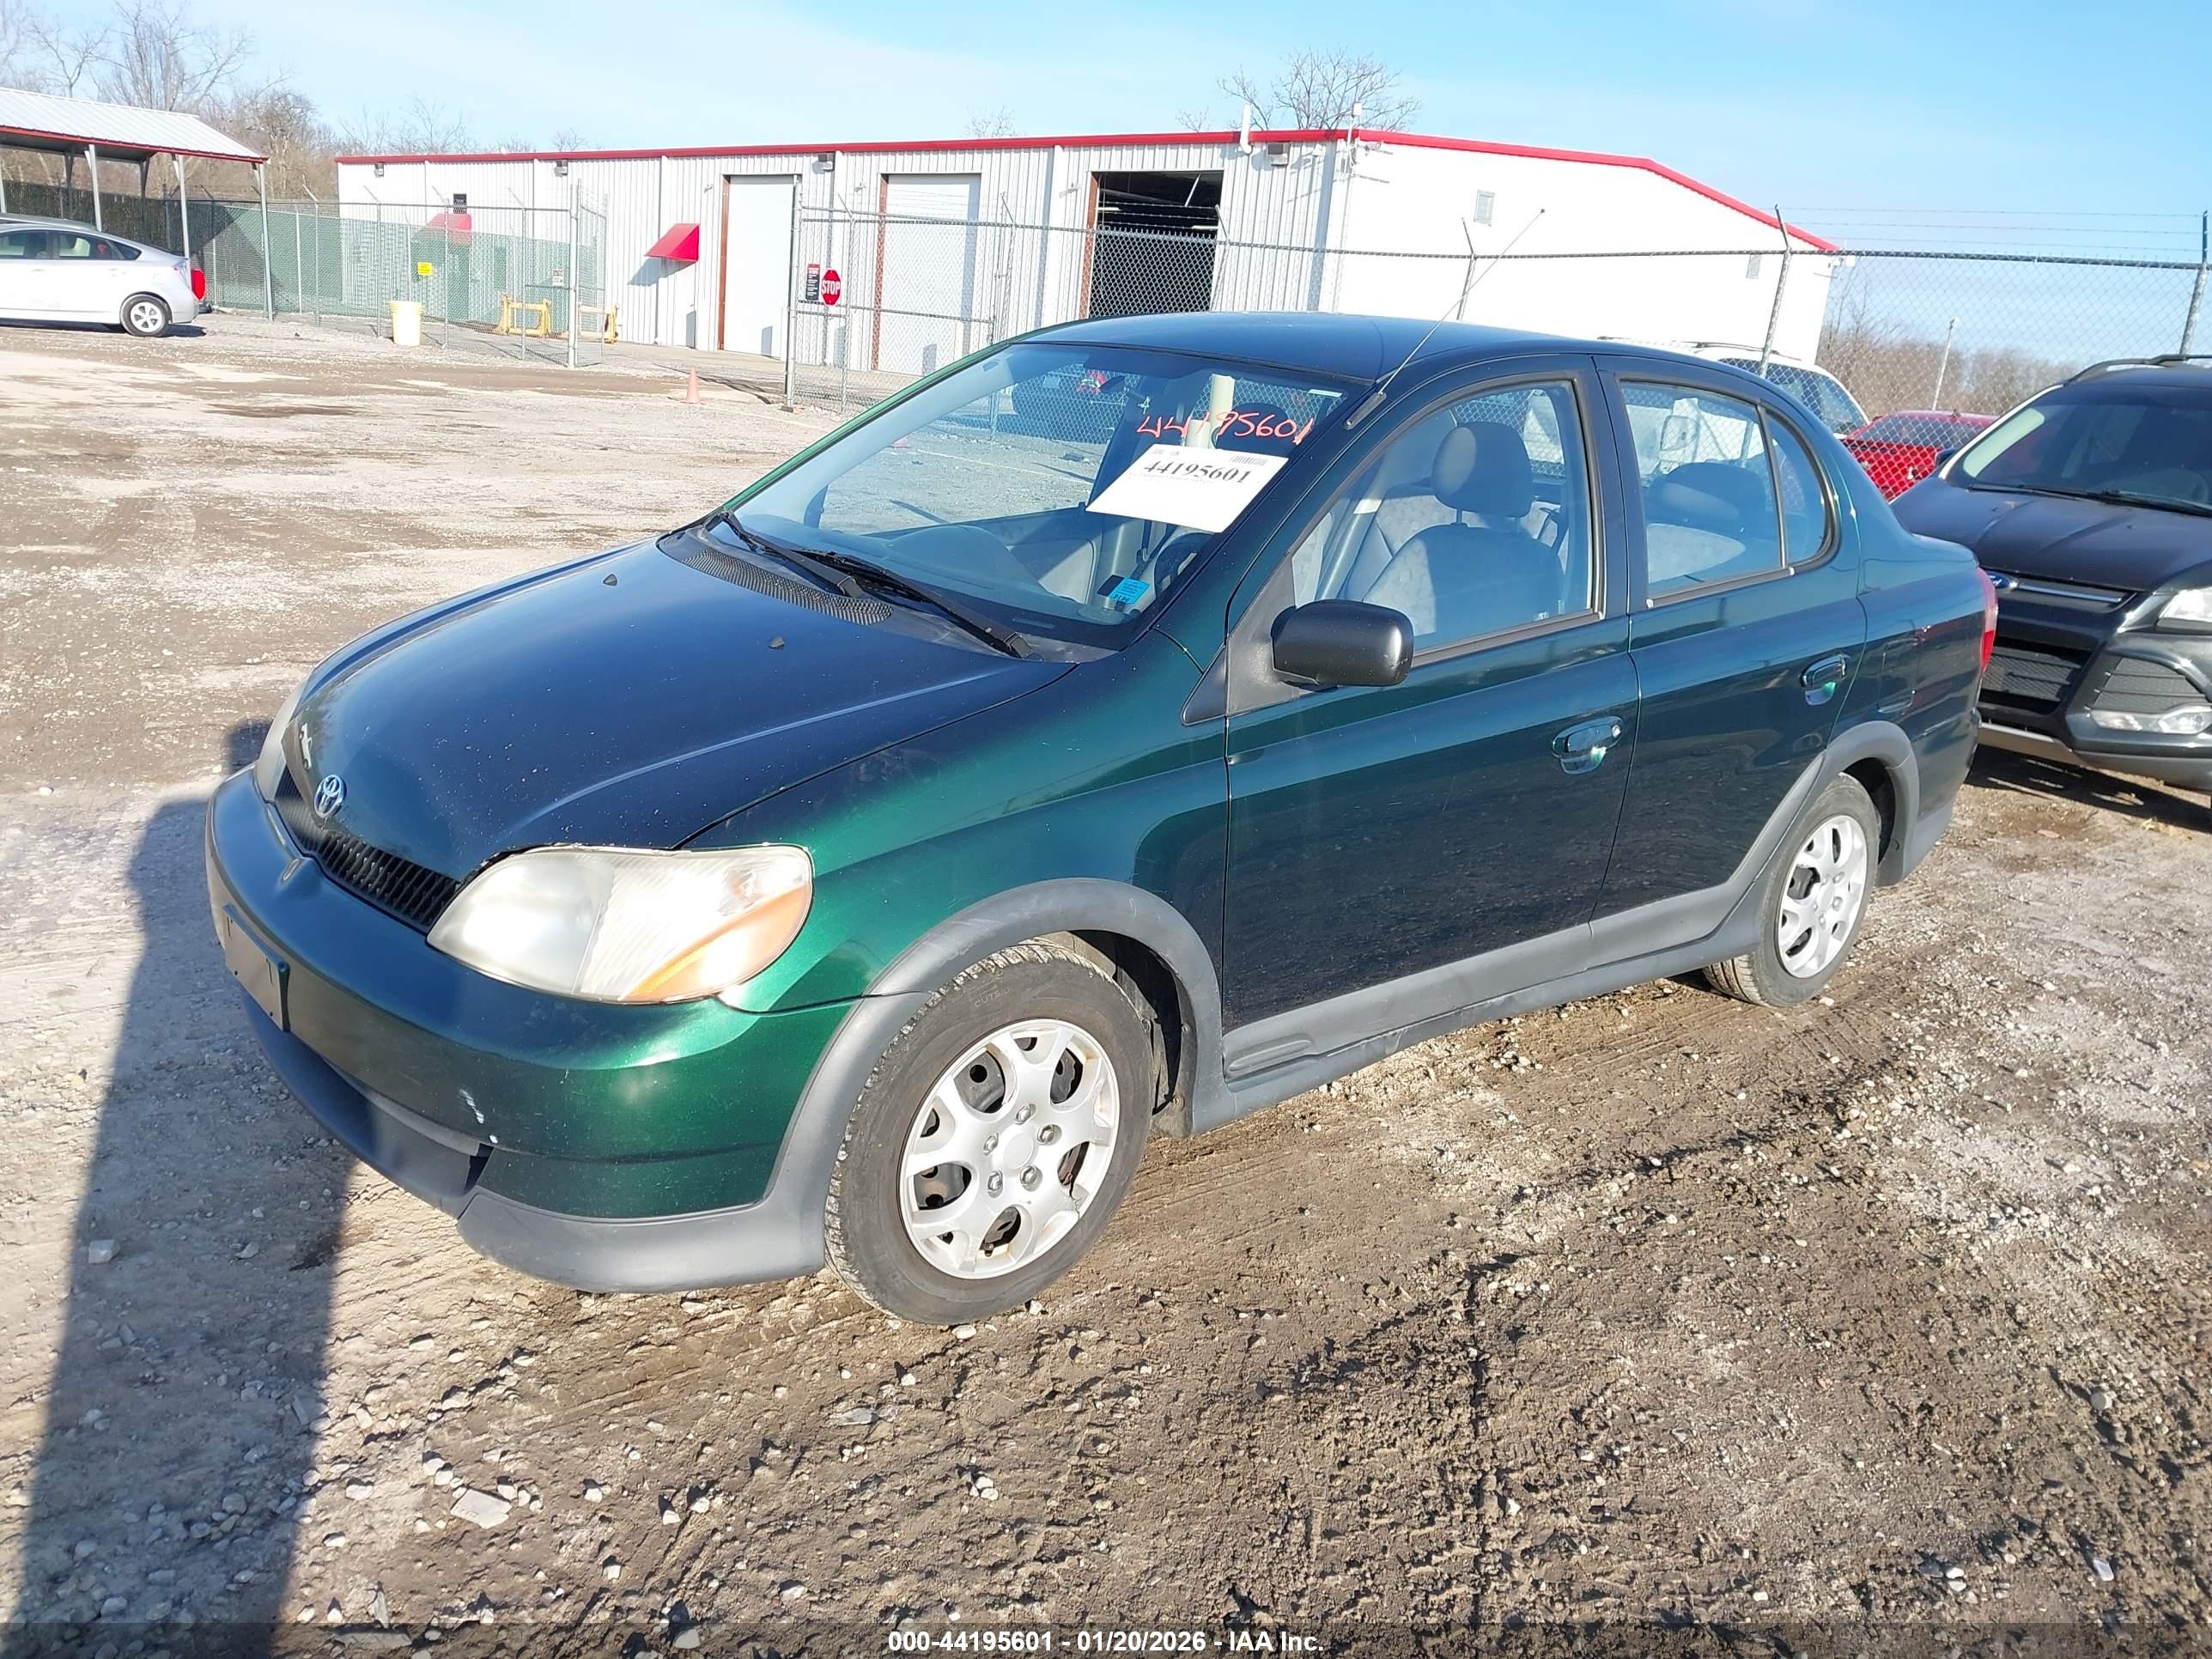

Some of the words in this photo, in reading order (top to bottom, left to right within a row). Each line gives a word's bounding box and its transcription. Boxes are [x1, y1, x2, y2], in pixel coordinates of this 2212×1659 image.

[822, 280, 841, 295] STOP
[1136, 410, 1314, 446] 44195601
[1144, 460, 1252, 483] 44195601
